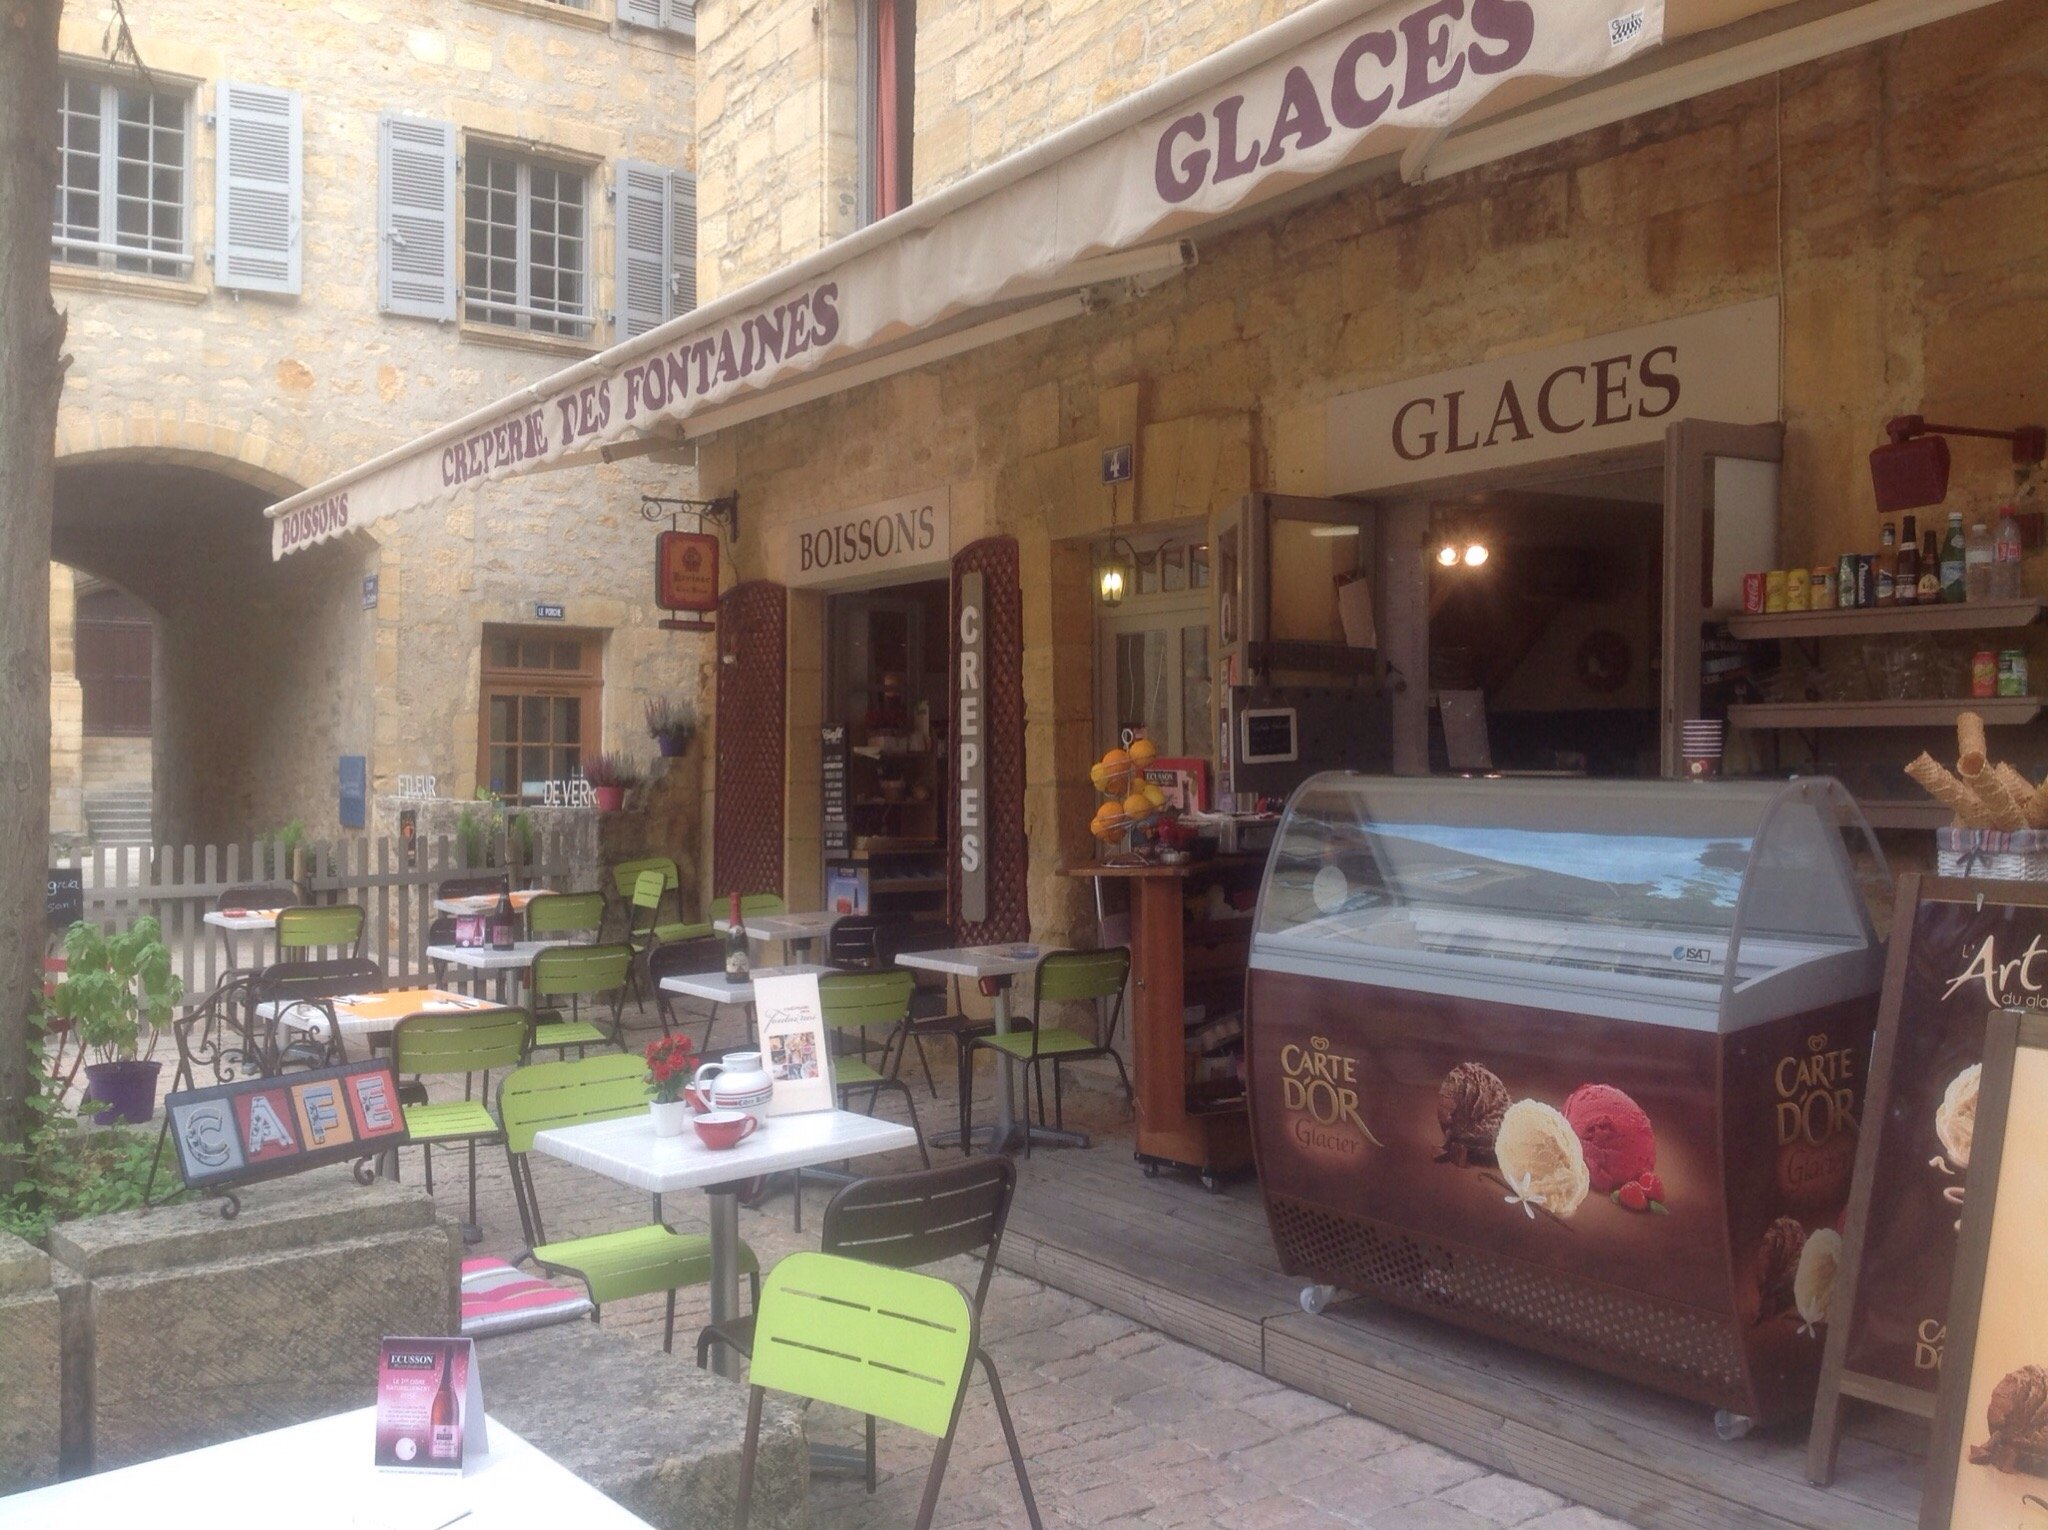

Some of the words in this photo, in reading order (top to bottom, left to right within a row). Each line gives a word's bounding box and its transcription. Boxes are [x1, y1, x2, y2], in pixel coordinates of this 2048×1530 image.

[1154, 0, 1535, 203] GLACES
[441, 407, 549, 487] CREPERIE
[556, 378, 612, 447] DES
[624, 281, 842, 421] FONTAINES
[1391, 345, 1681, 461] GLACES
[1110, 452, 1120, 478] 4
[281, 492, 349, 550] BOISSONS
[800, 505, 935, 571] BOISSONS
[960, 604, 979, 872] CREPES
[1686, 947, 1703, 960] ISA
[2001, 992, 2022, 1006] du
[1281, 1044, 1357, 1085] CARTE
[1775, 1049, 1854, 1098] CARTE
[186, 1076, 394, 1167] CAFE
[1282, 1075, 1384, 1147] D'OR
[1295, 1119, 1358, 1154] Glacier
[1776, 1088, 1860, 1146] D'OR
[390, 1354, 434, 1364] ECUSSON
